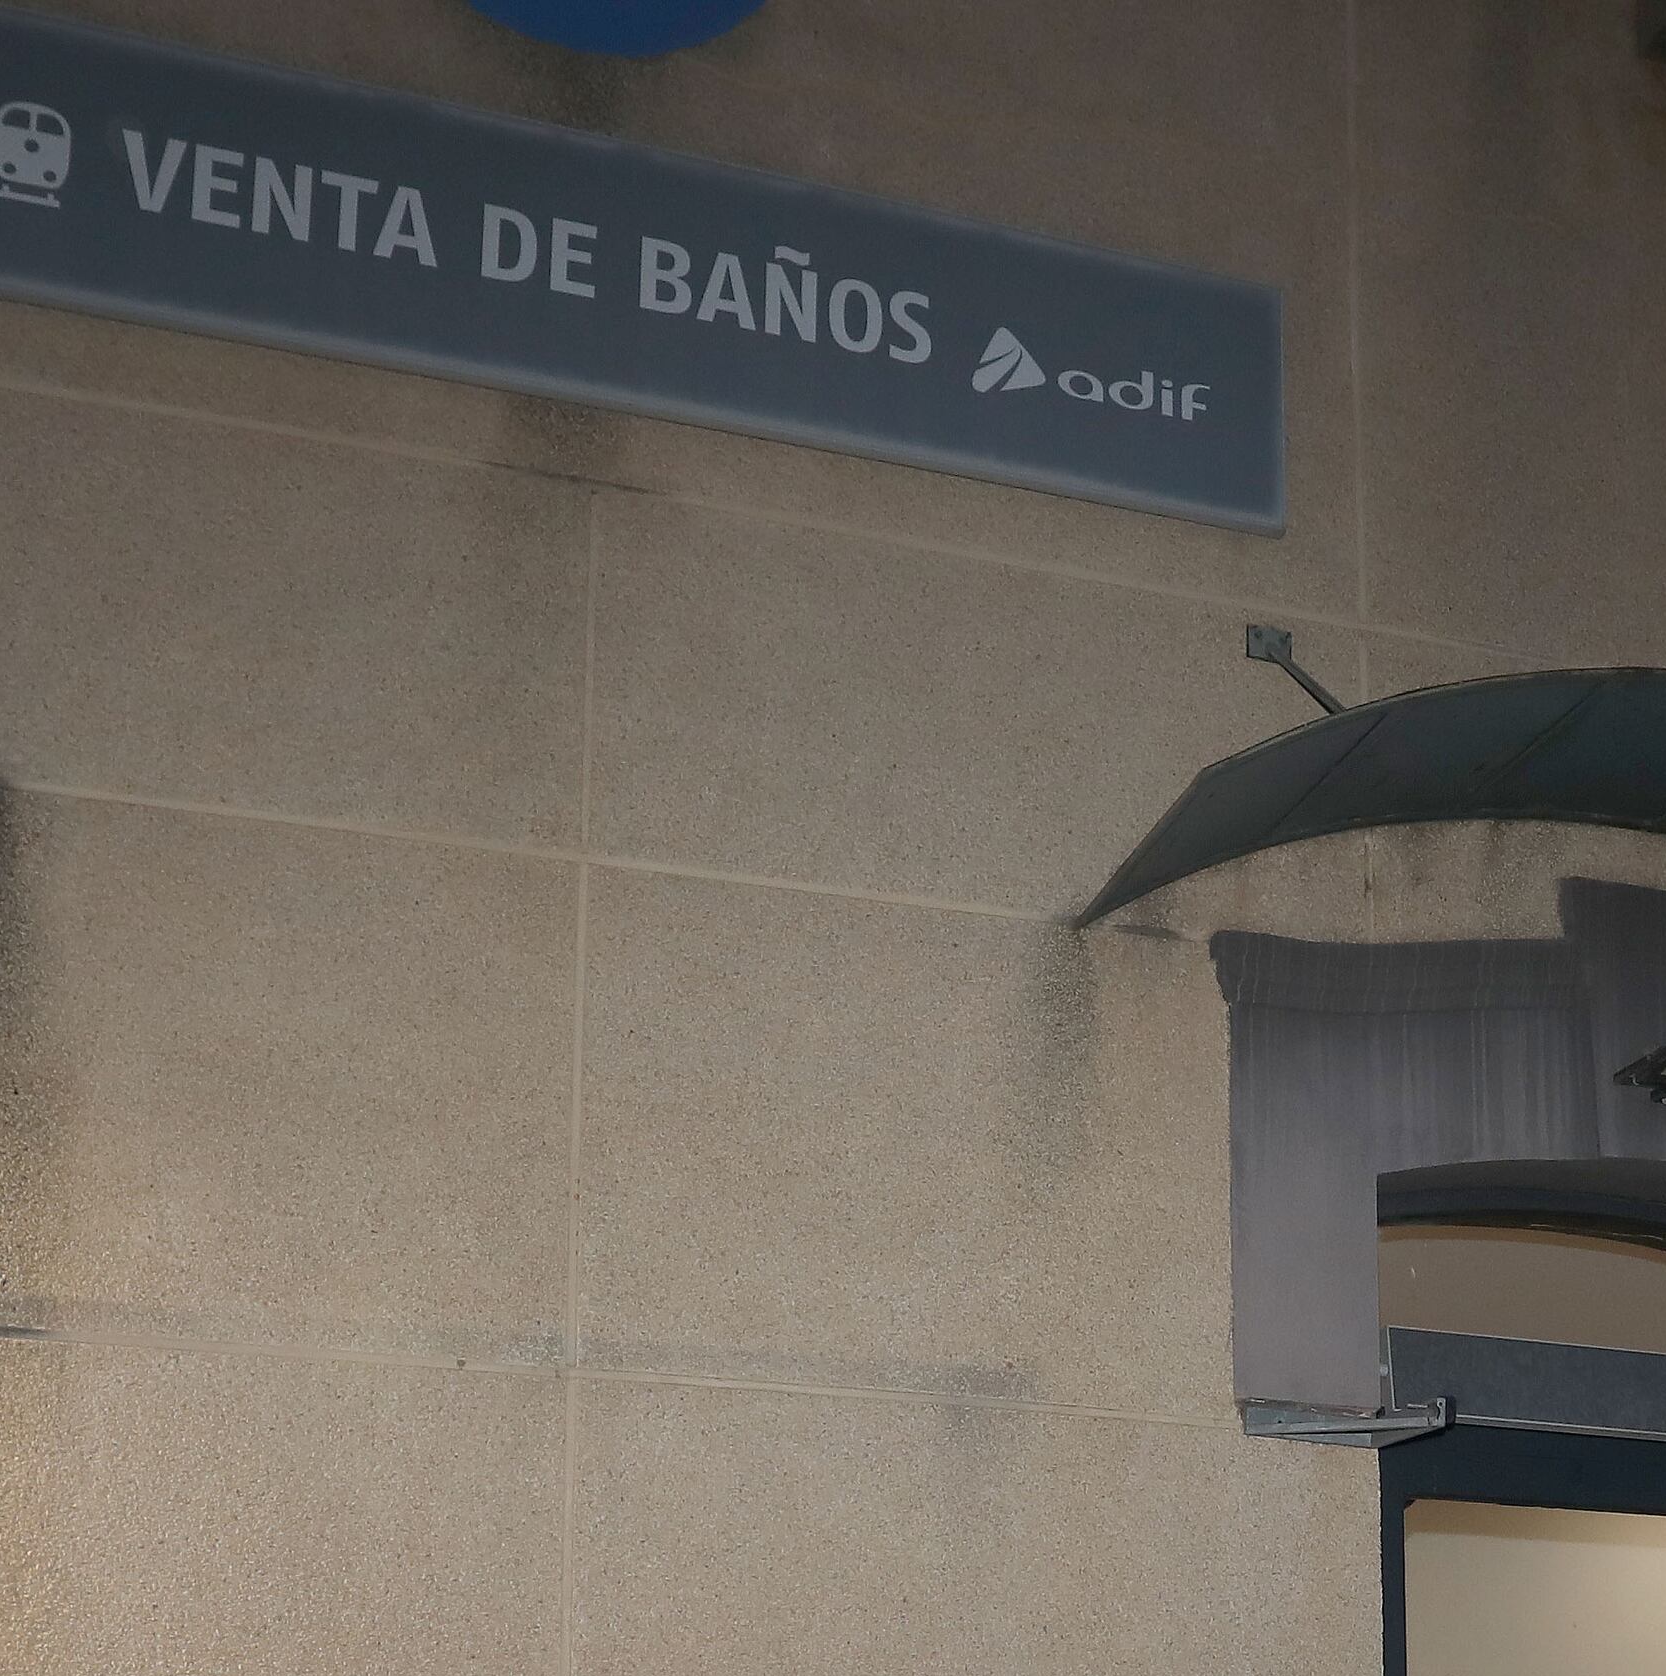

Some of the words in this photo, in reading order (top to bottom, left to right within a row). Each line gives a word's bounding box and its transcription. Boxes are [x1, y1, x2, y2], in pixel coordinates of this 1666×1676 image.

[122, 128, 438, 268] VENTA
[480, 202, 599, 298] DE
[639, 245, 933, 364] BAÑOS
[1057, 370, 1211, 421] adif
